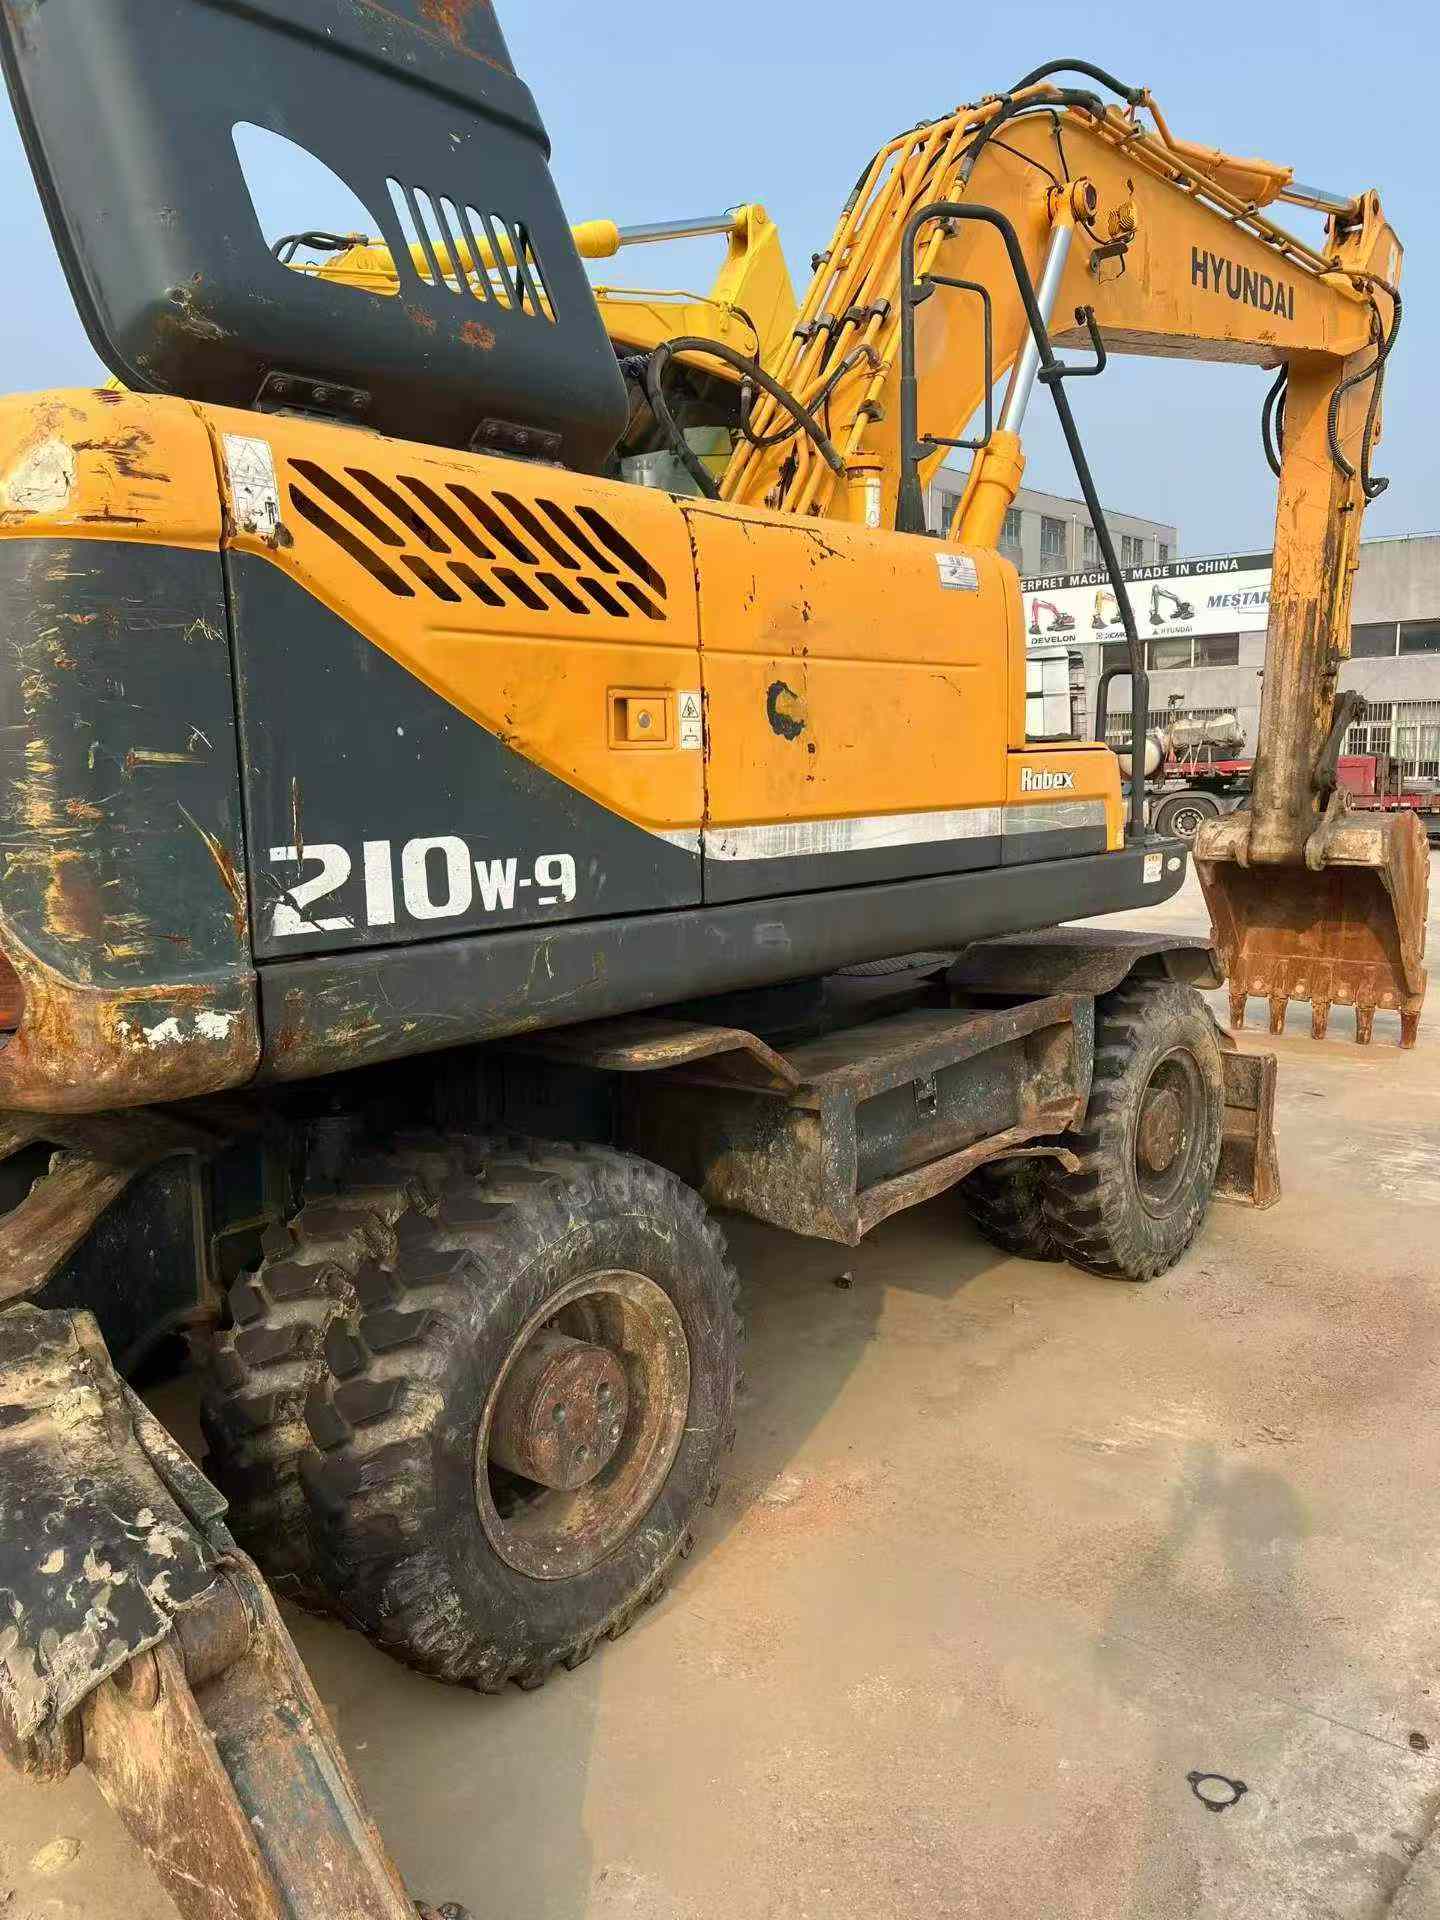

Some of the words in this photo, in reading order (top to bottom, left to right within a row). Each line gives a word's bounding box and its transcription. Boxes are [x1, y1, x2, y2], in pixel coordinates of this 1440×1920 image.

[1191, 246, 1294, 321] HYUNDAI
[1020, 577, 1064, 592] ERPRET
[1069, 570, 1126, 586] MACHIE
[1132, 566, 1169, 580] MADE
[1176, 563, 1190, 576] IN
[1196, 559, 1239, 573] CHINA
[1031, 635, 1076, 645] DEVELON
[1161, 625, 1192, 634] HYUNDAI
[1021, 767, 1074, 791] Robex
